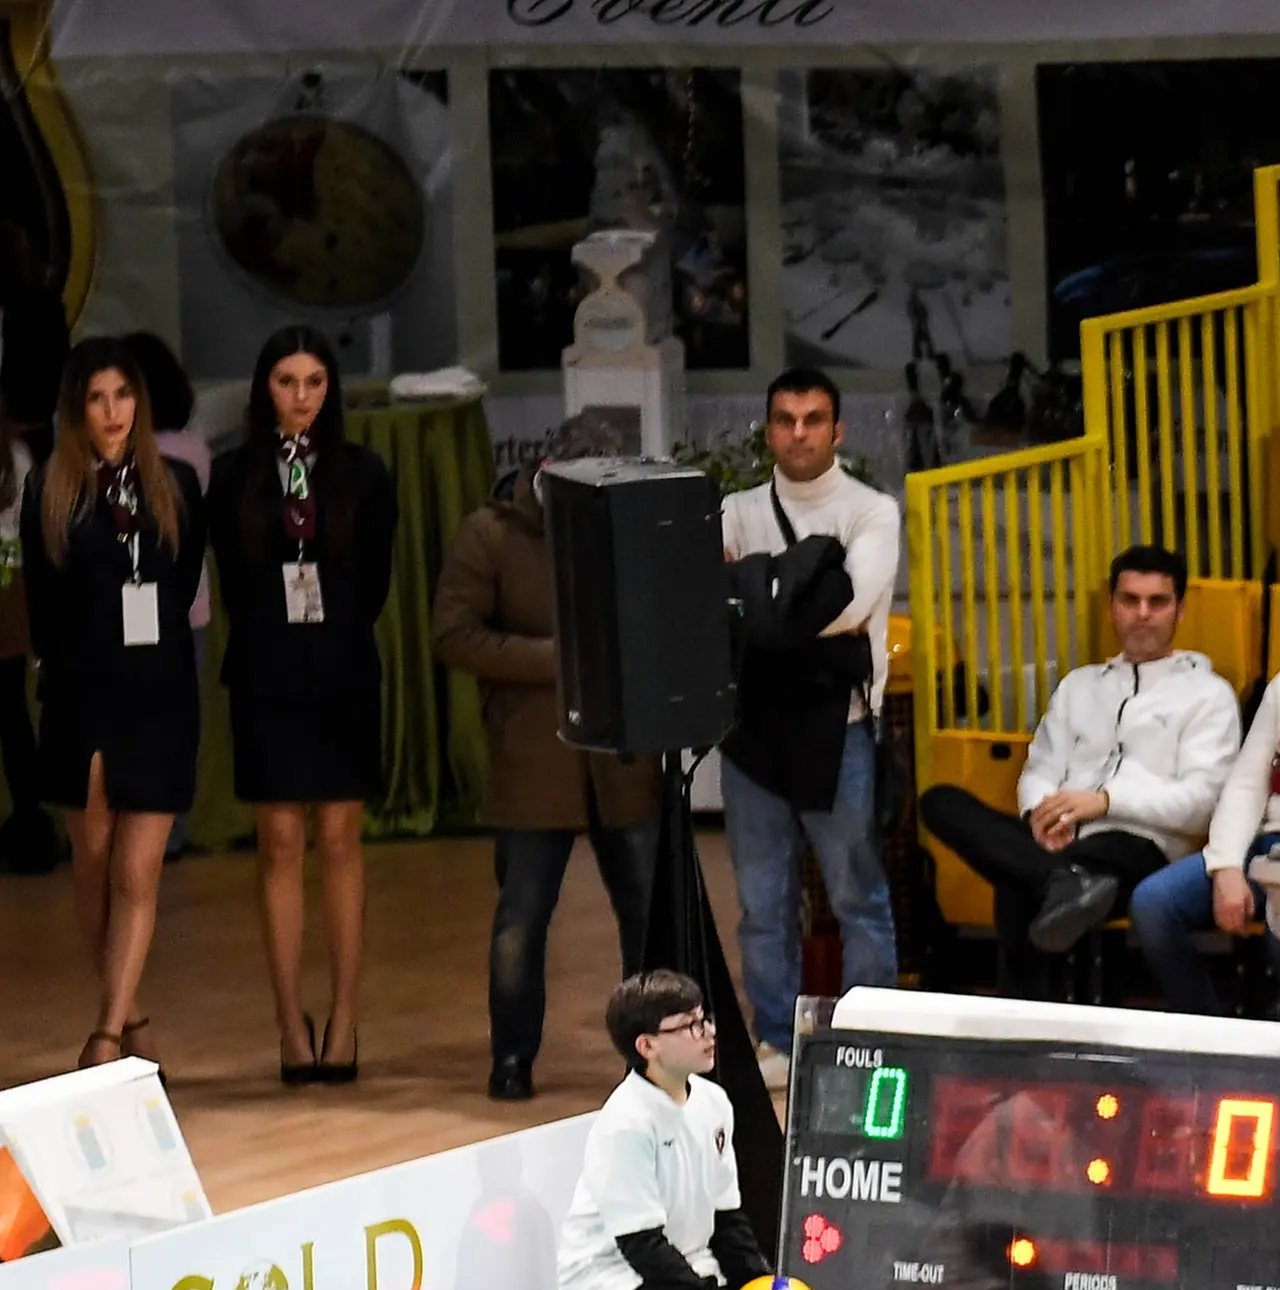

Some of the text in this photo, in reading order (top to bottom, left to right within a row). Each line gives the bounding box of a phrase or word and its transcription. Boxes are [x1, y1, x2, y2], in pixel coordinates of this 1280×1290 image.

[836, 1046, 882, 1069] FOULS
[864, 1067, 906, 1138] 0
[1207, 1099, 1274, 1197] 0
[800, 1157, 902, 1202] HOME
[893, 1262, 944, 1284] TIME-OUT
